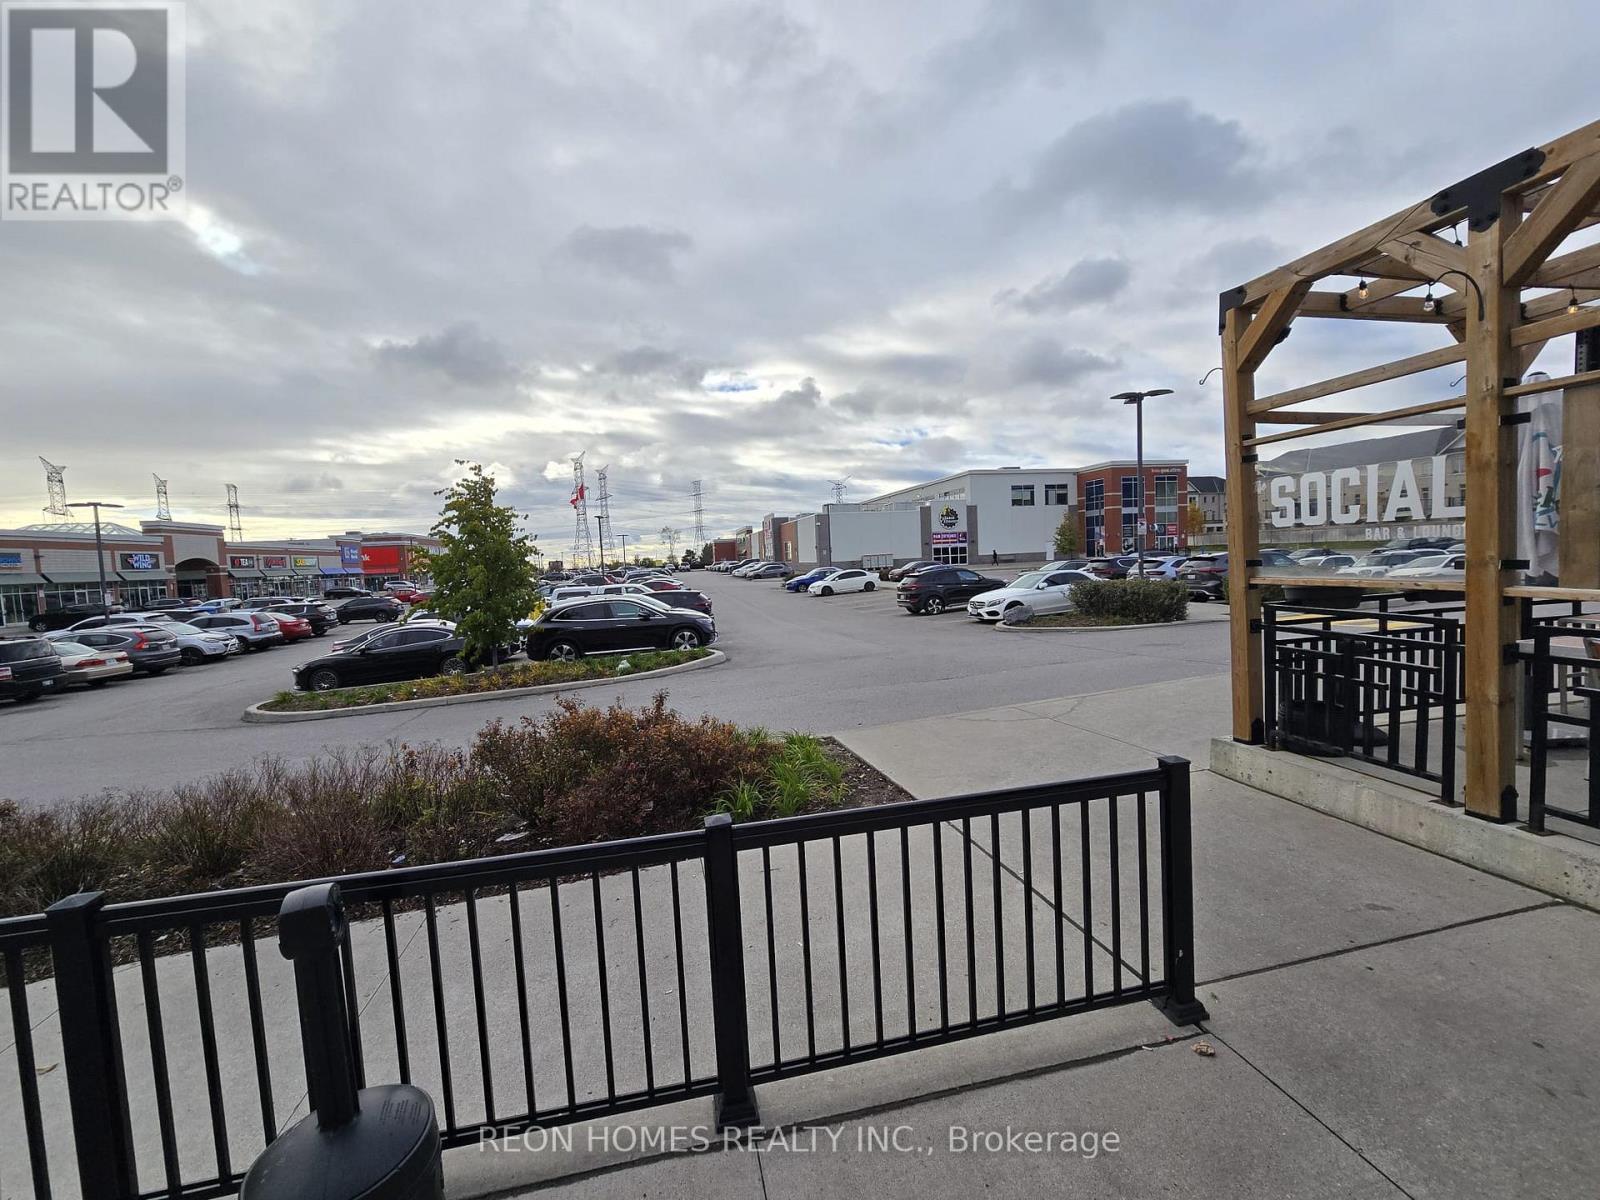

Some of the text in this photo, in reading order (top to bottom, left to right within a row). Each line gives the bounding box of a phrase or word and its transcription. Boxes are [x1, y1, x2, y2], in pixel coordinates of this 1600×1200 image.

[1270, 455, 1466, 528] SOCIAL
[1365, 526, 1390, 540] BAR
[133, 560, 152, 569] WING
